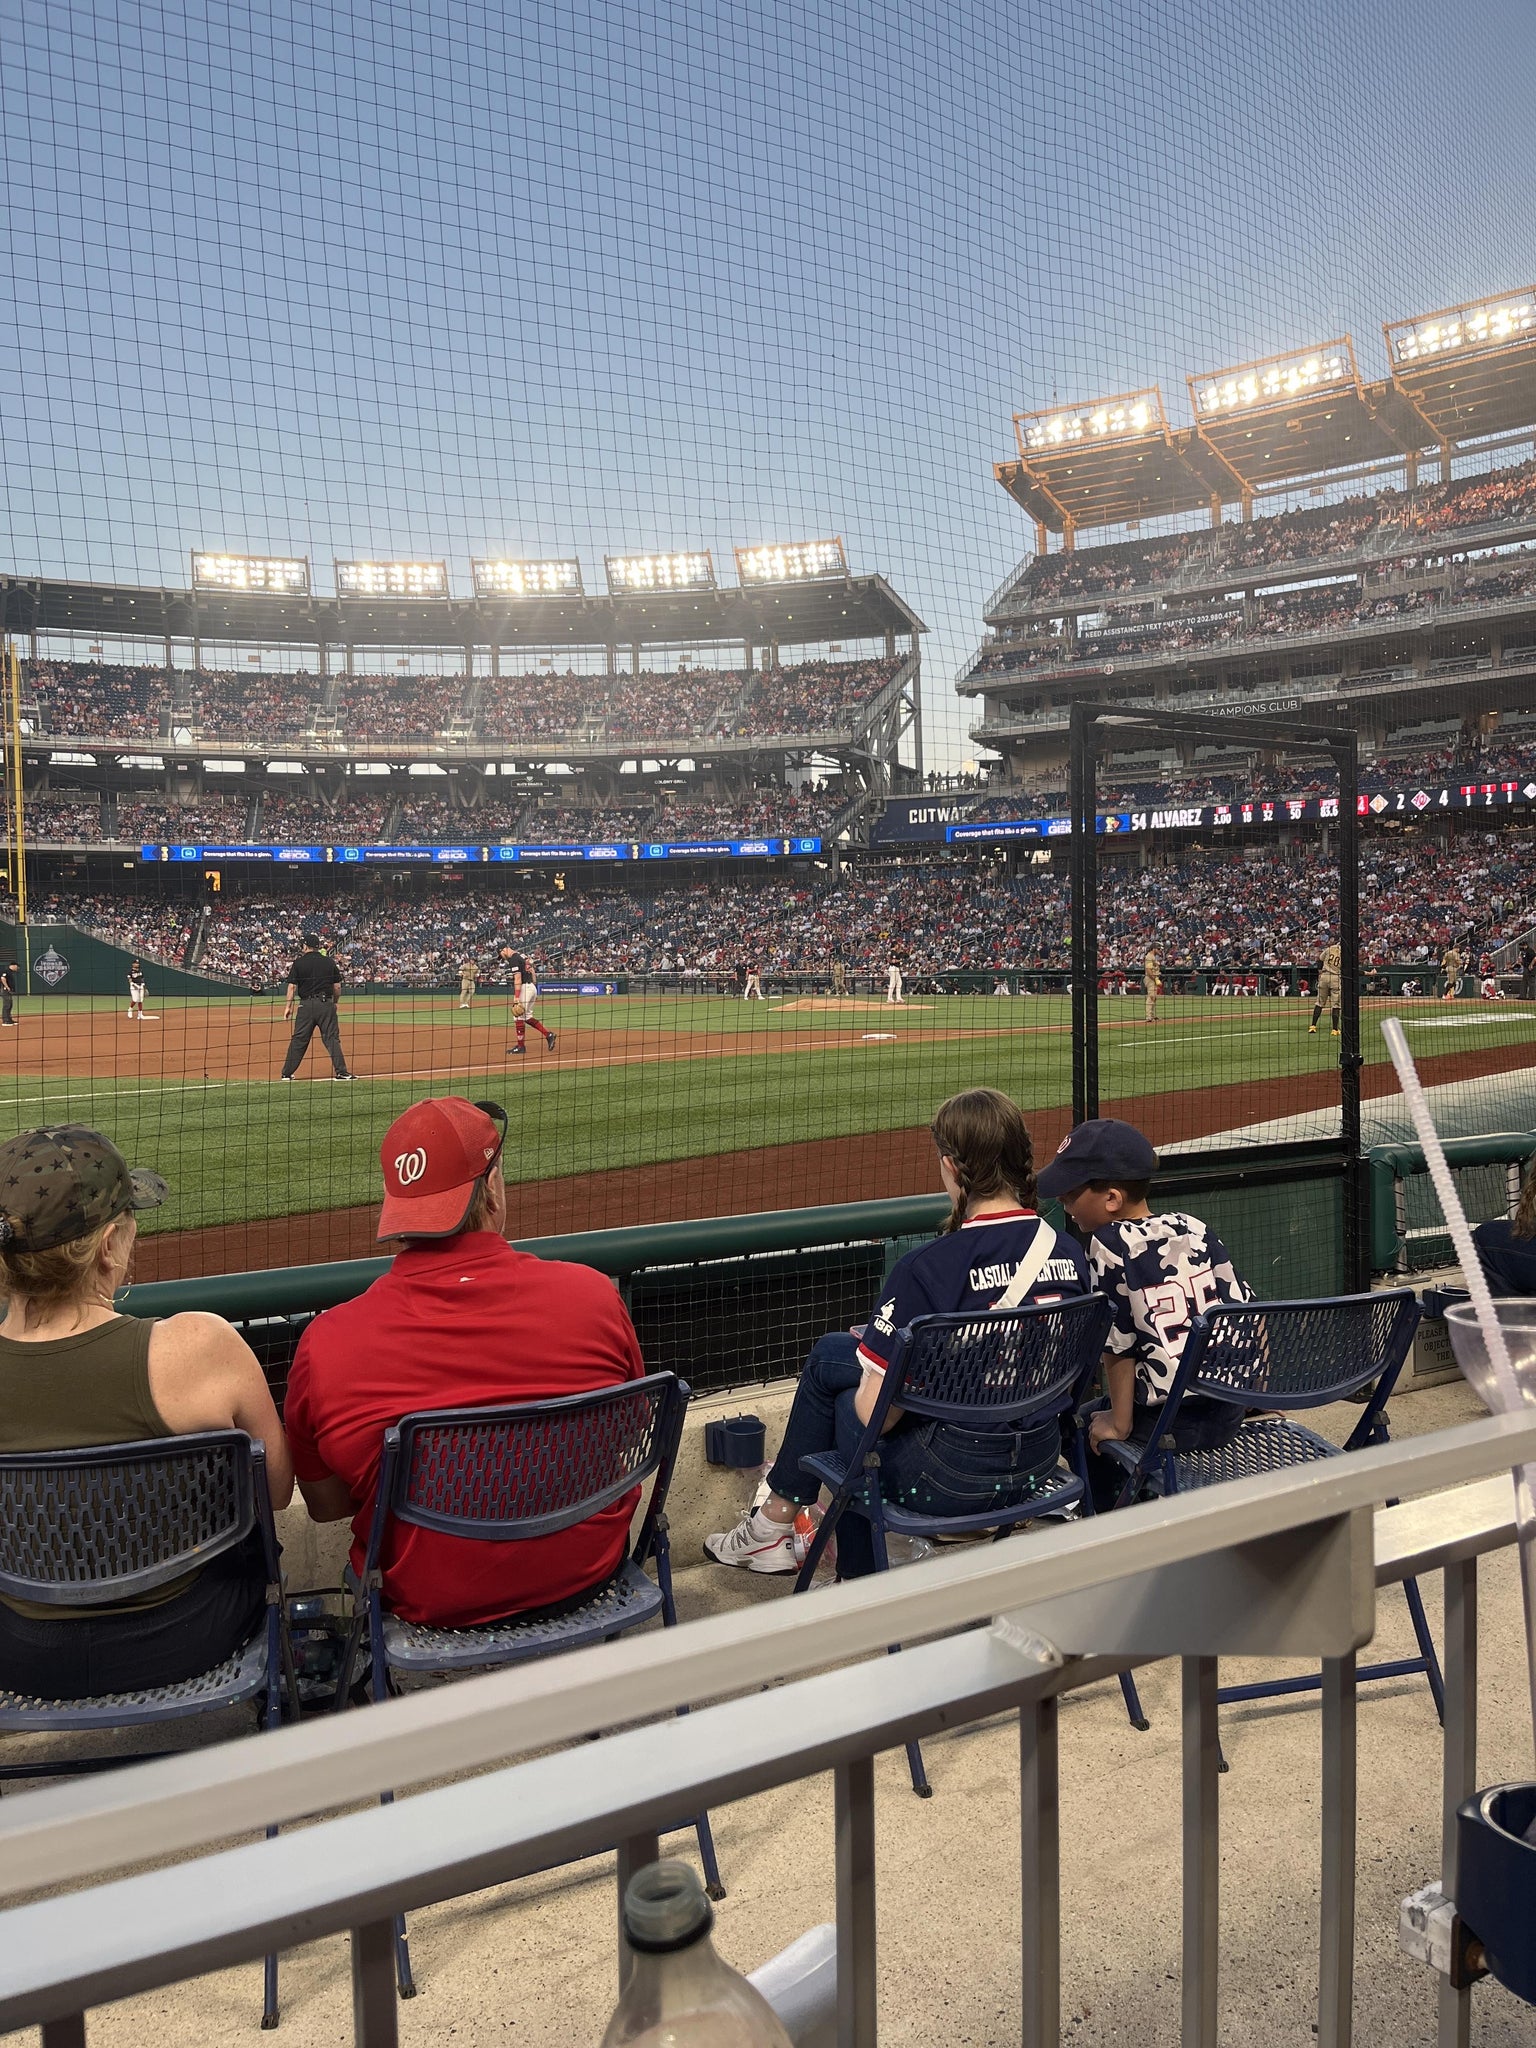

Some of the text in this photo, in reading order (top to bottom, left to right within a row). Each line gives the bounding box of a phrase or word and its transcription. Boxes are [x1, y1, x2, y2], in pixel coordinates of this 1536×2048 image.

[1103, 625, 1144, 636] ASSISTANCE?
[1145, 622, 1162, 631] TEXT
[1205, 700, 1298, 717] HAMPIONS CLUB
[1396, 793, 1405, 810] 2
[1439, 790, 1449, 806] 4
[1465, 794, 1471, 807] 1
[1485, 792, 1493, 805] 2
[1507, 791, 1512, 803] 1
[909, 806, 976, 824] CUTWAT
[1242, 812, 1252, 823] 18
[1262, 810, 1274, 821] 32
[1290, 808, 1302, 820] 50
[1320, 806, 1339, 818] 83.6
[1131, 808, 1203, 831] 54 ALVAREZ
[1213, 813, 1232, 825] 3.00
[1020, 827, 1038, 835] glove.
[1328, 953, 1340, 967] 20
[394, 1147, 427, 1185] W
[969, 1261, 1013, 1292] CASUAL
[1417, 1327, 1443, 1340] PLEASE
[1424, 1338, 1451, 1352] OBJECT
[1436, 1350, 1450, 1362] THE
